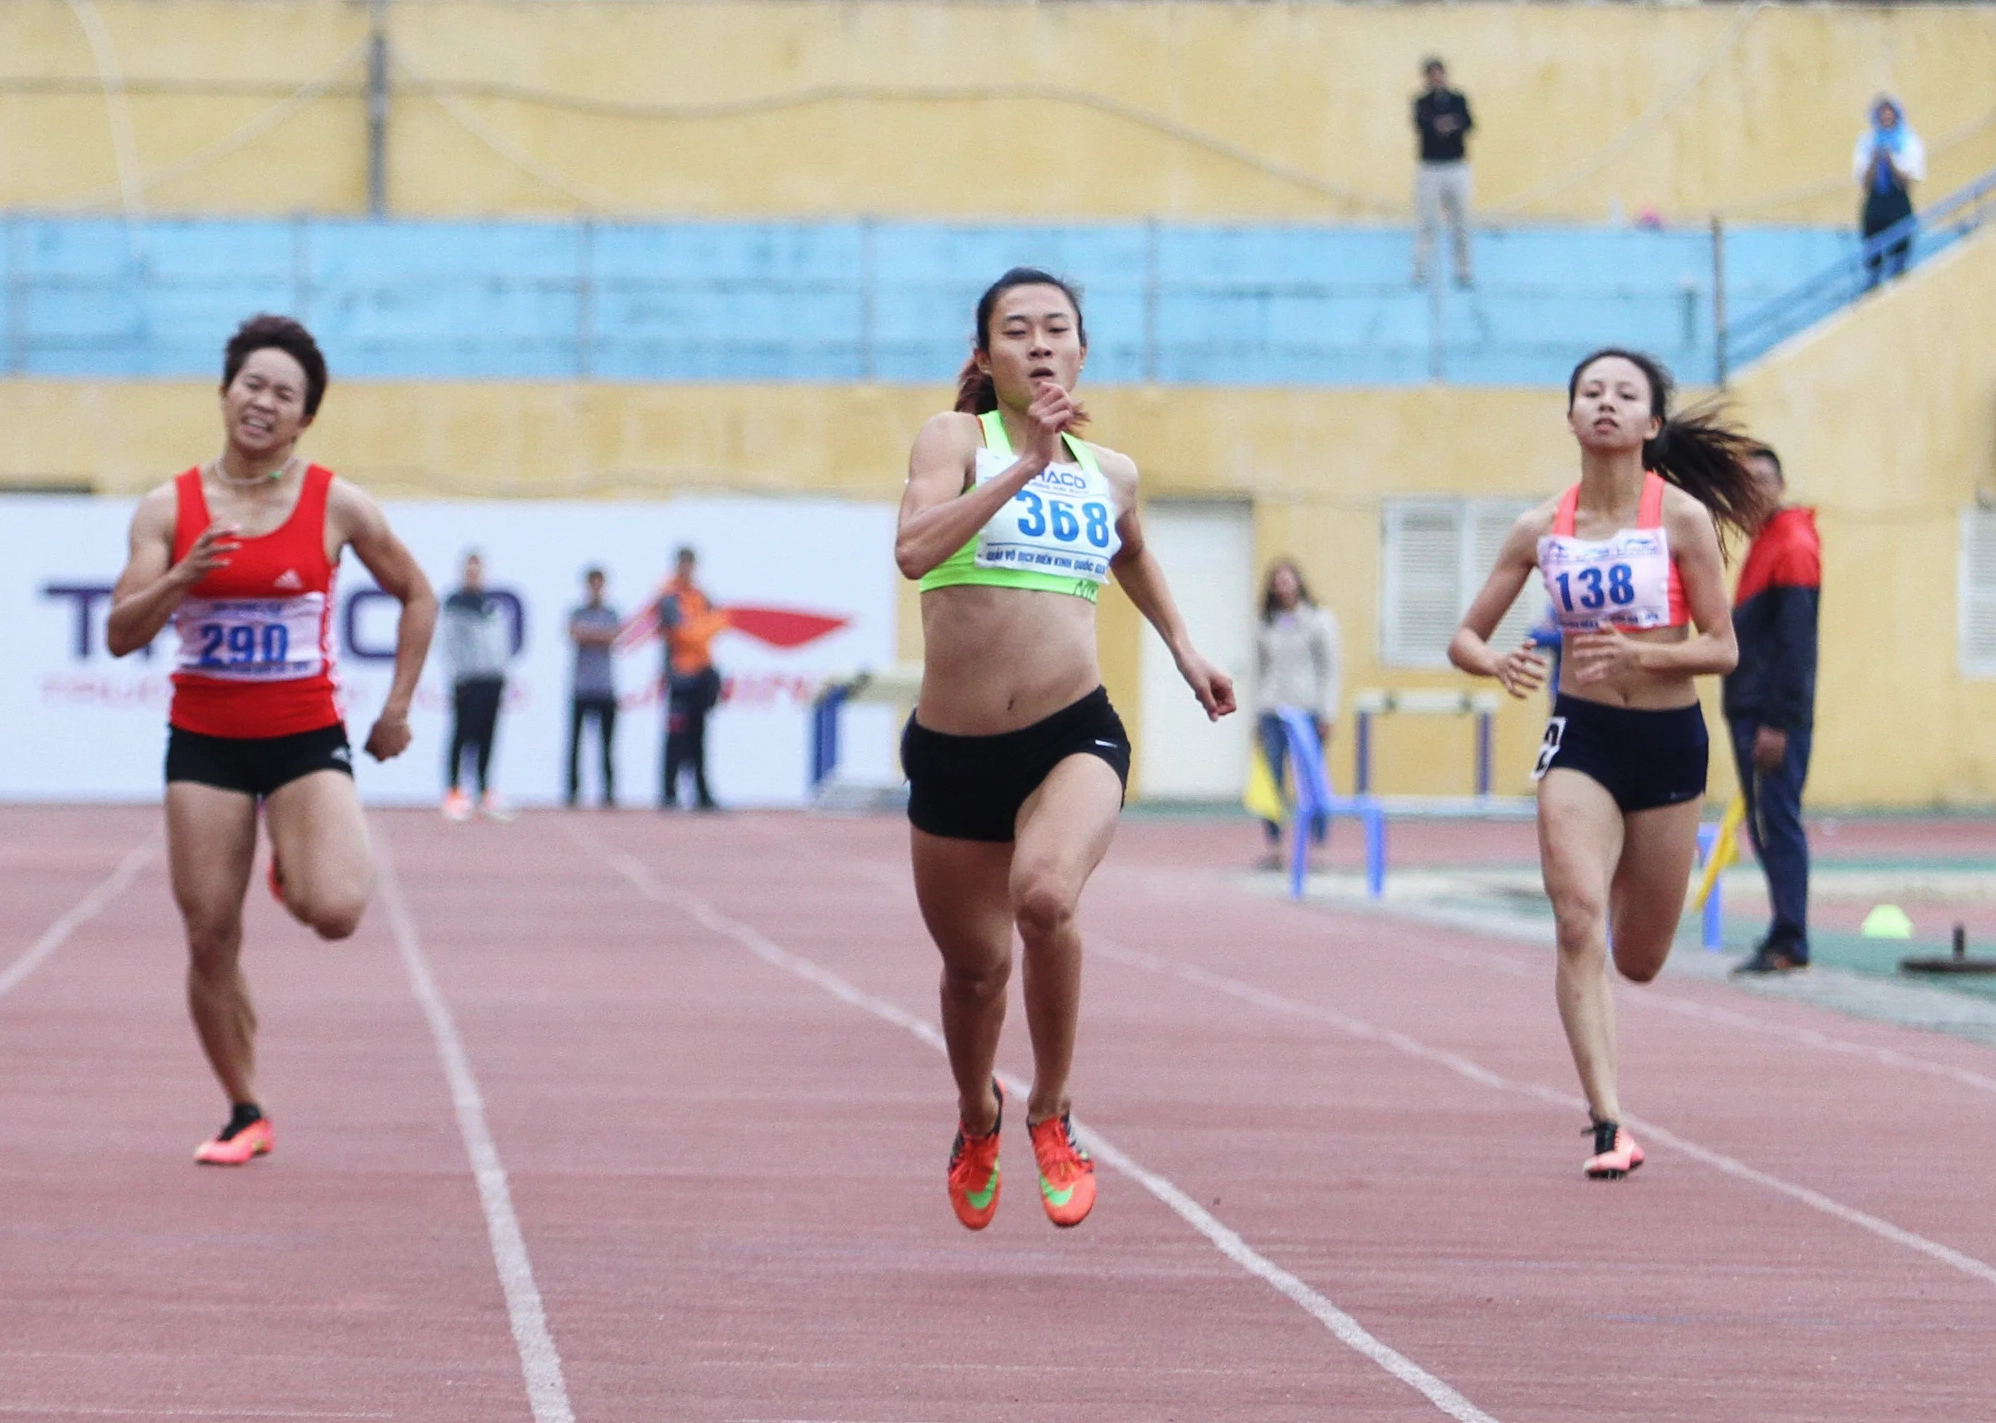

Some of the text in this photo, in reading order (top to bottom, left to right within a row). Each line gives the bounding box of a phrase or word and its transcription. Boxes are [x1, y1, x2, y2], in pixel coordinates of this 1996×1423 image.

[1016, 490, 1110, 548] 368
[1555, 563, 1635, 612] 138
[199, 622, 289, 666] 290
